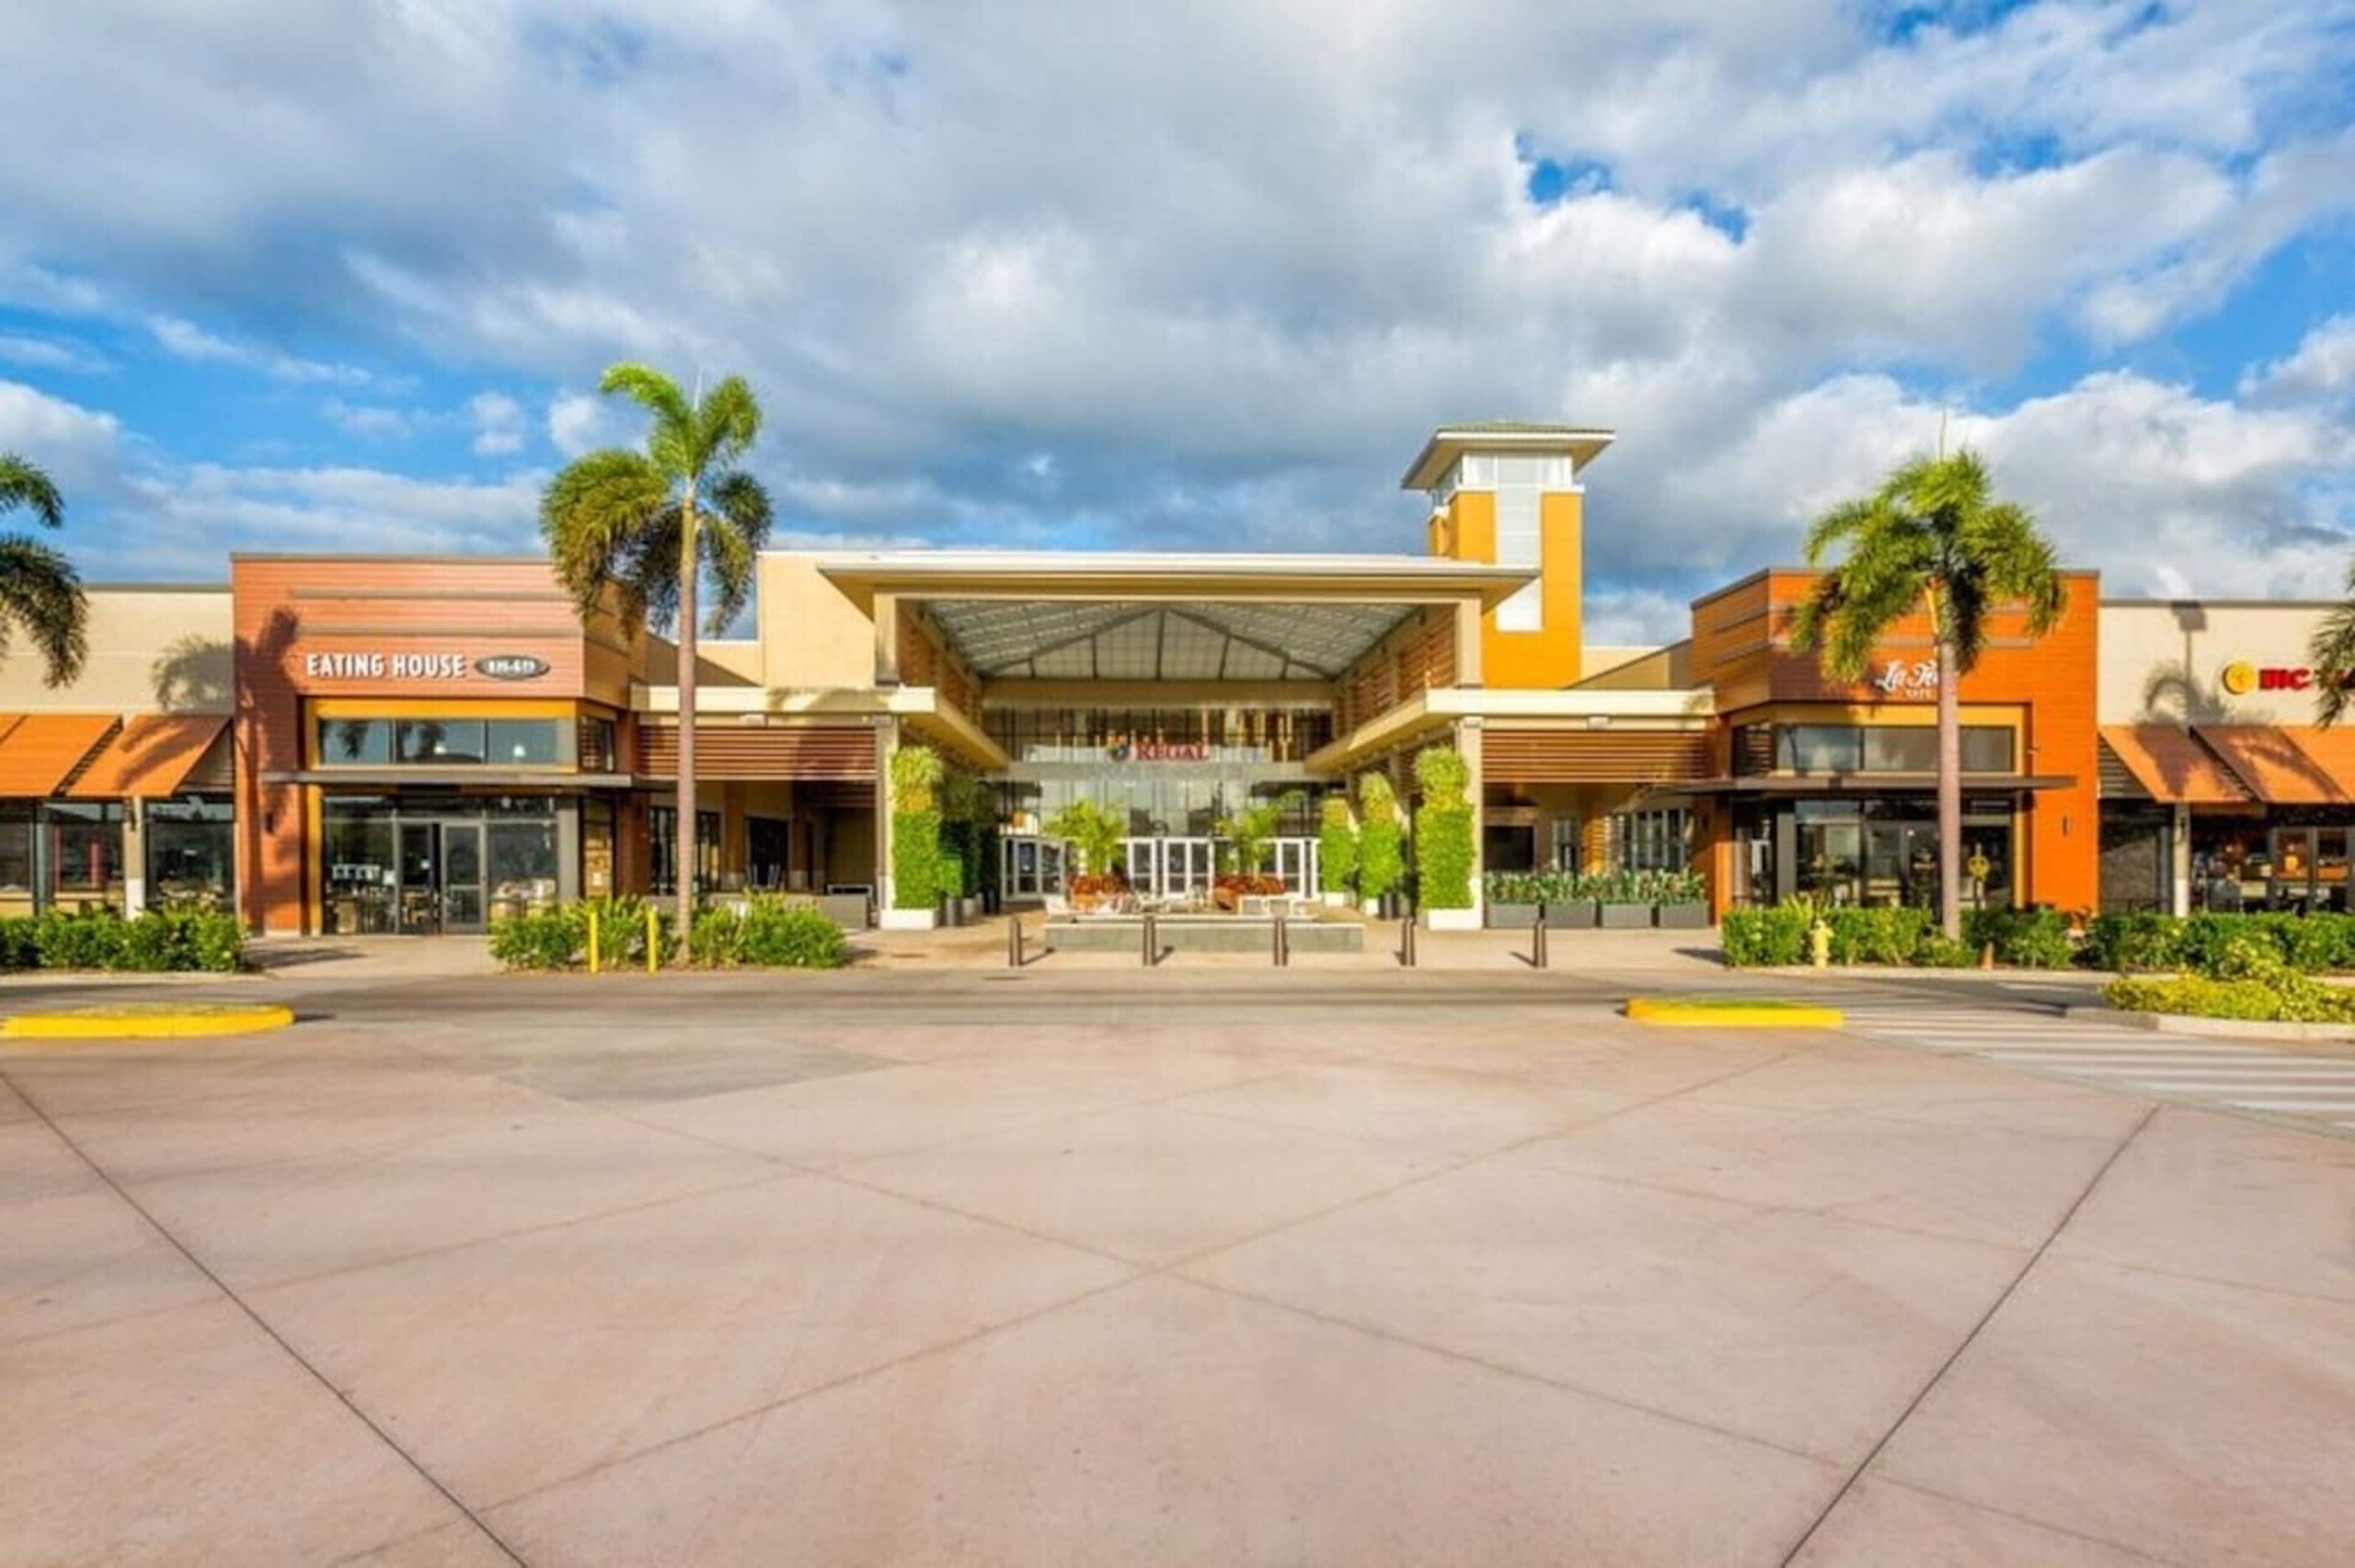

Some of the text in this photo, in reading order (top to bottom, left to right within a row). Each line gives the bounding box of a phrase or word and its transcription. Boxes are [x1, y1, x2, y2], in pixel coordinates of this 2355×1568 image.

[306, 653, 385, 678] EATING
[392, 654, 465, 678] HOUSE
[1875, 659, 1907, 692] La
